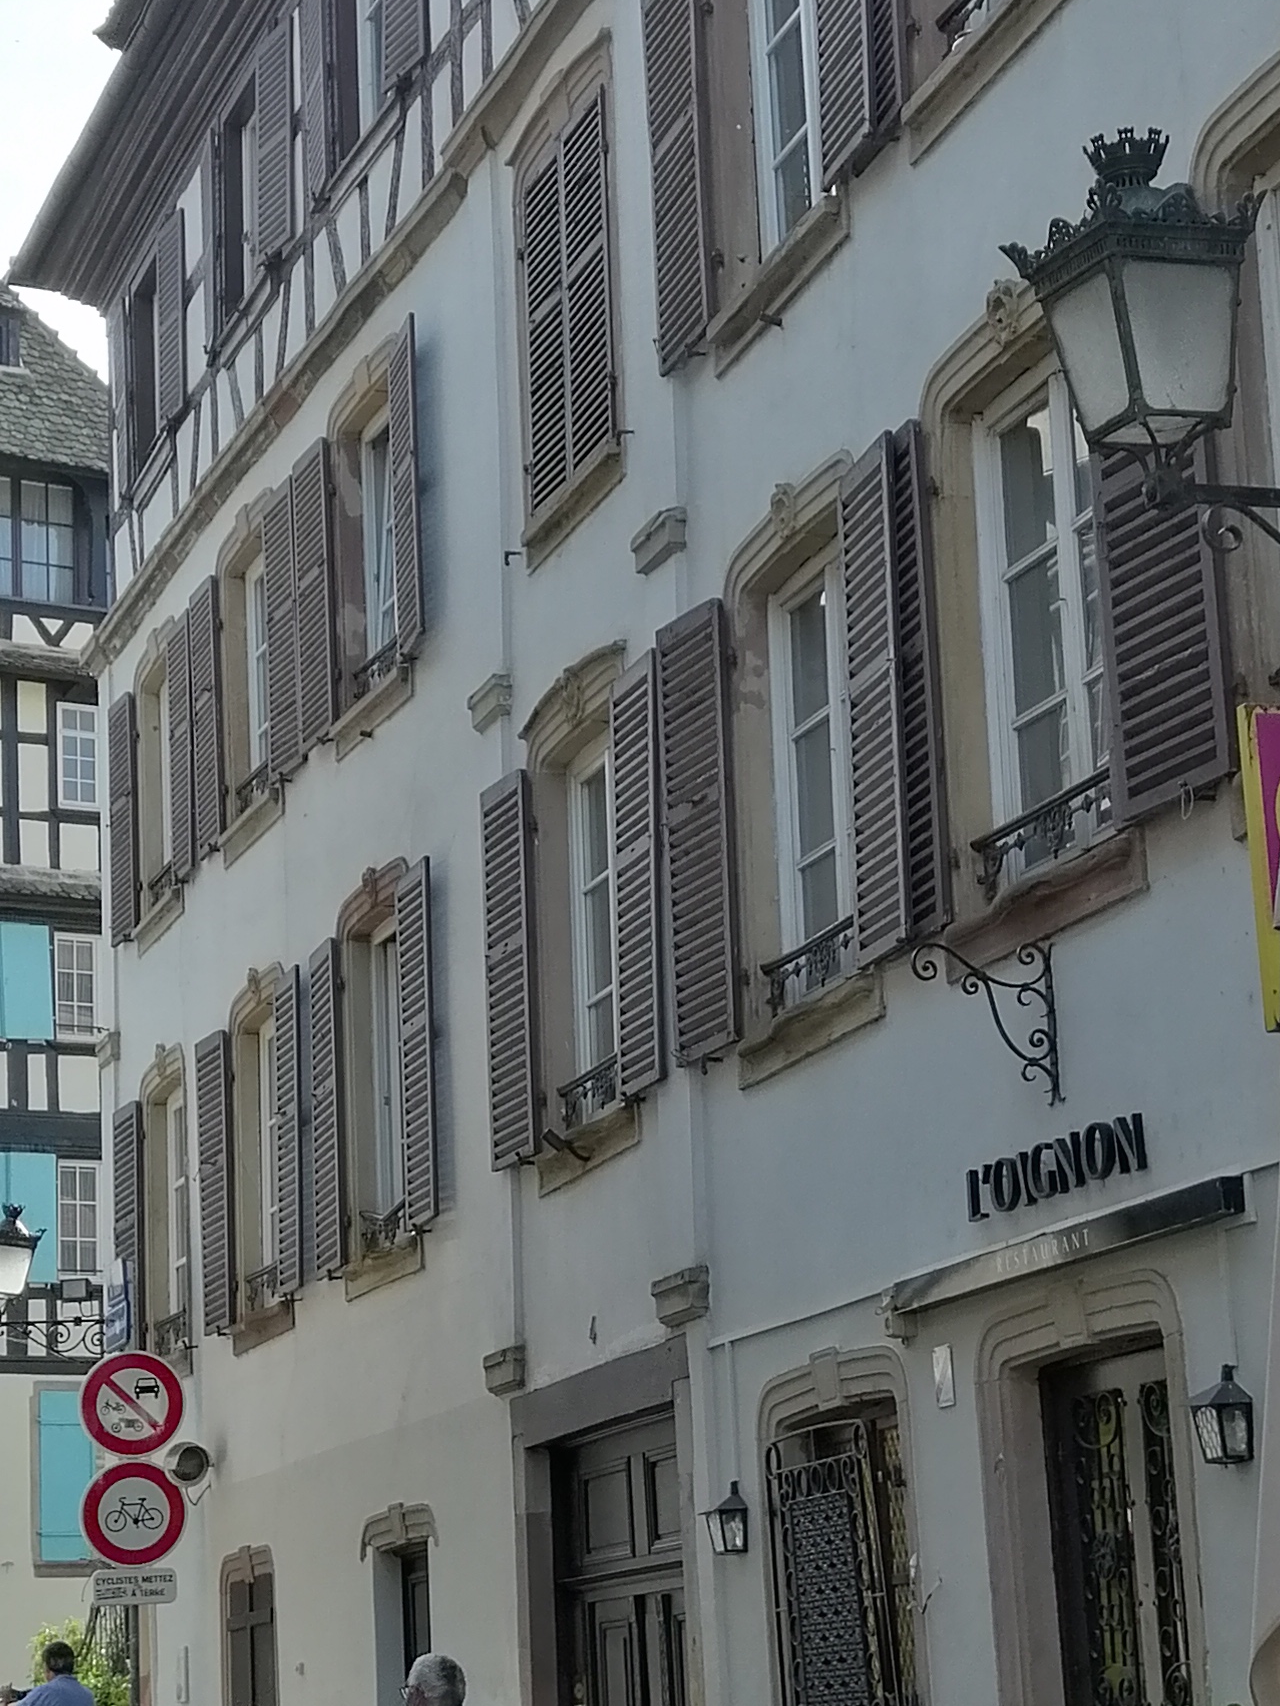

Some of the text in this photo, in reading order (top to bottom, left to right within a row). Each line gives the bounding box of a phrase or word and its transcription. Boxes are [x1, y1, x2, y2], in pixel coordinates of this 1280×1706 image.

[966, 1112, 1148, 1222] L'OIGNON
[996, 1228, 1090, 1273] RESTAURANT
[96, 1574, 173, 1586] CYCLISTES METTEZ
